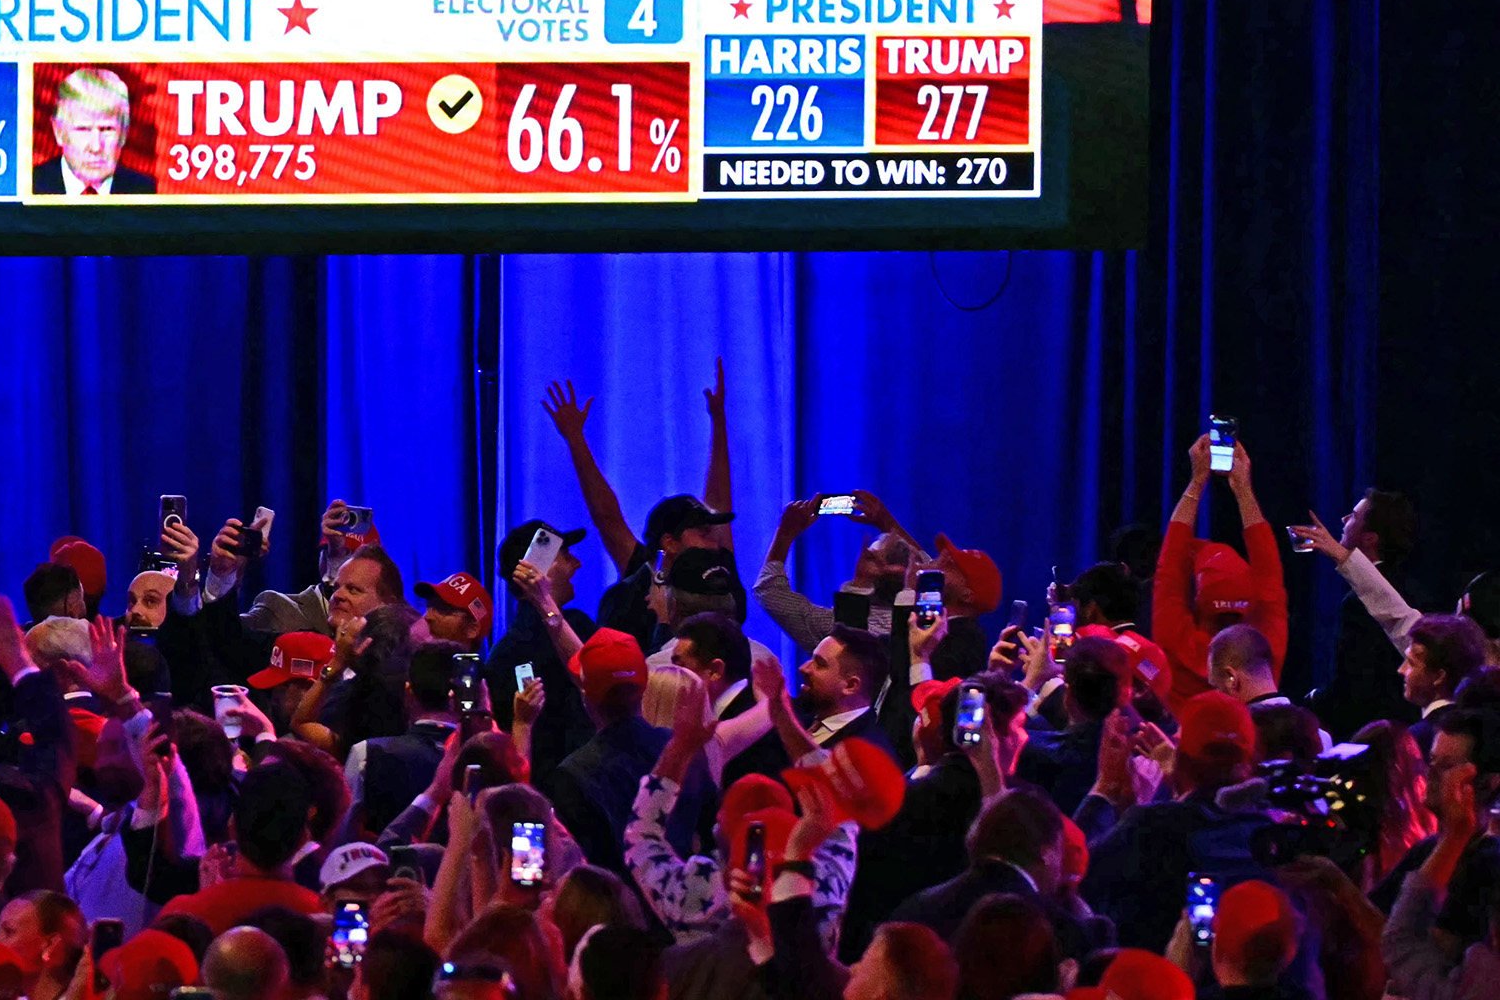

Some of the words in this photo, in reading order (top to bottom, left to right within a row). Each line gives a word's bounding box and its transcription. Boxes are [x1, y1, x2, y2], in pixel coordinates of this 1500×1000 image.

[497, 18, 590, 43] VOTES
[709, 37, 863, 76] HARRIS
[881, 38, 1026, 76] TRUMP
[167, 78, 403, 137] TRUMP
[506, 83, 682, 174] 66.1%
[750, 84, 824, 142] 226
[916, 85, 990, 141] 277
[167, 143, 317, 187] 398,775
[719, 159, 823, 186] NEEDED
[829, 160, 866, 186] TO
[872, 159, 946, 186] WIN:
[955, 156, 1008, 186] 270
